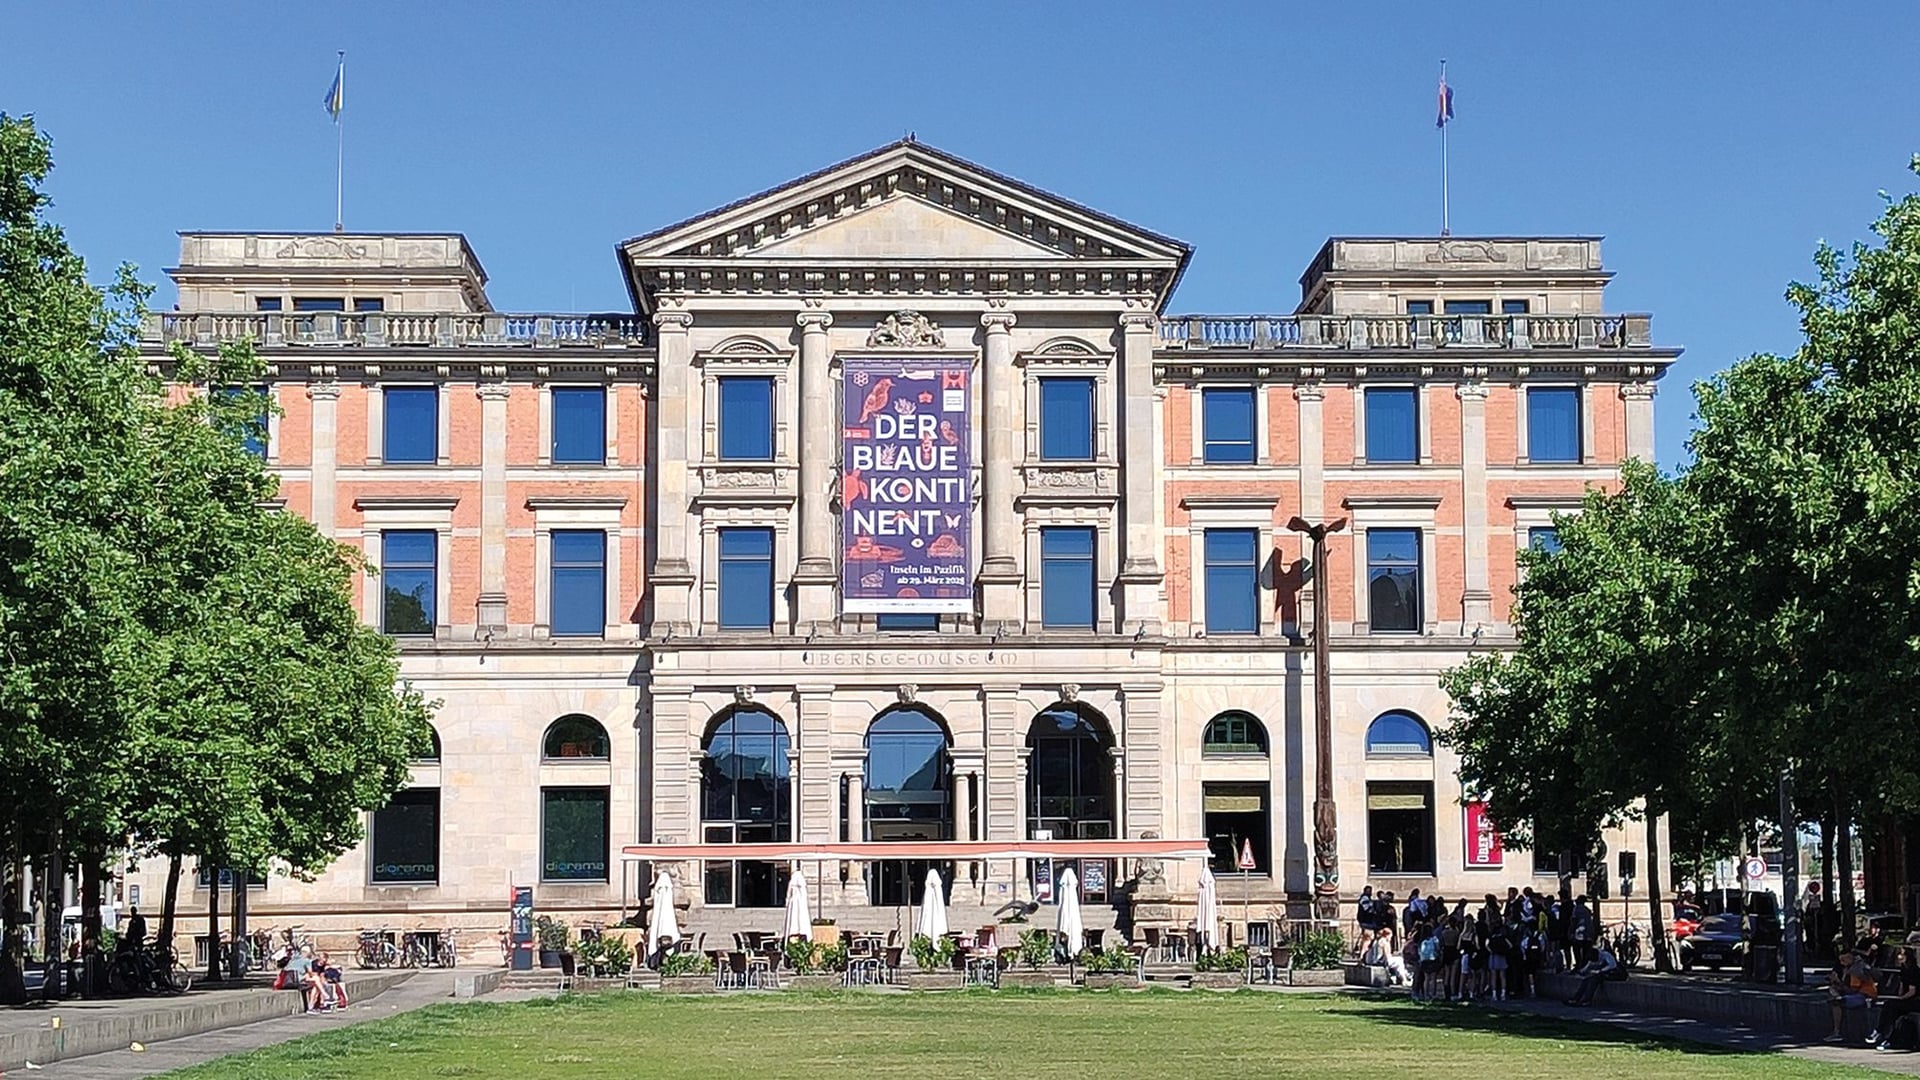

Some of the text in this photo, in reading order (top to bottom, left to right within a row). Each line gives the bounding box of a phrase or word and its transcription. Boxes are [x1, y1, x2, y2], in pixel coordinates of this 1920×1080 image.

[875, 414, 938, 439] DER
[853, 445, 958, 471] BLAUE
[870, 478, 965, 503] KONTI
[853, 509, 941, 535] NENT
[890, 565, 966, 574] Inseln im Pazifik
[897, 576, 909, 585] ab
[375, 863, 435, 873] diorama
[545, 861, 605, 871] diorama
